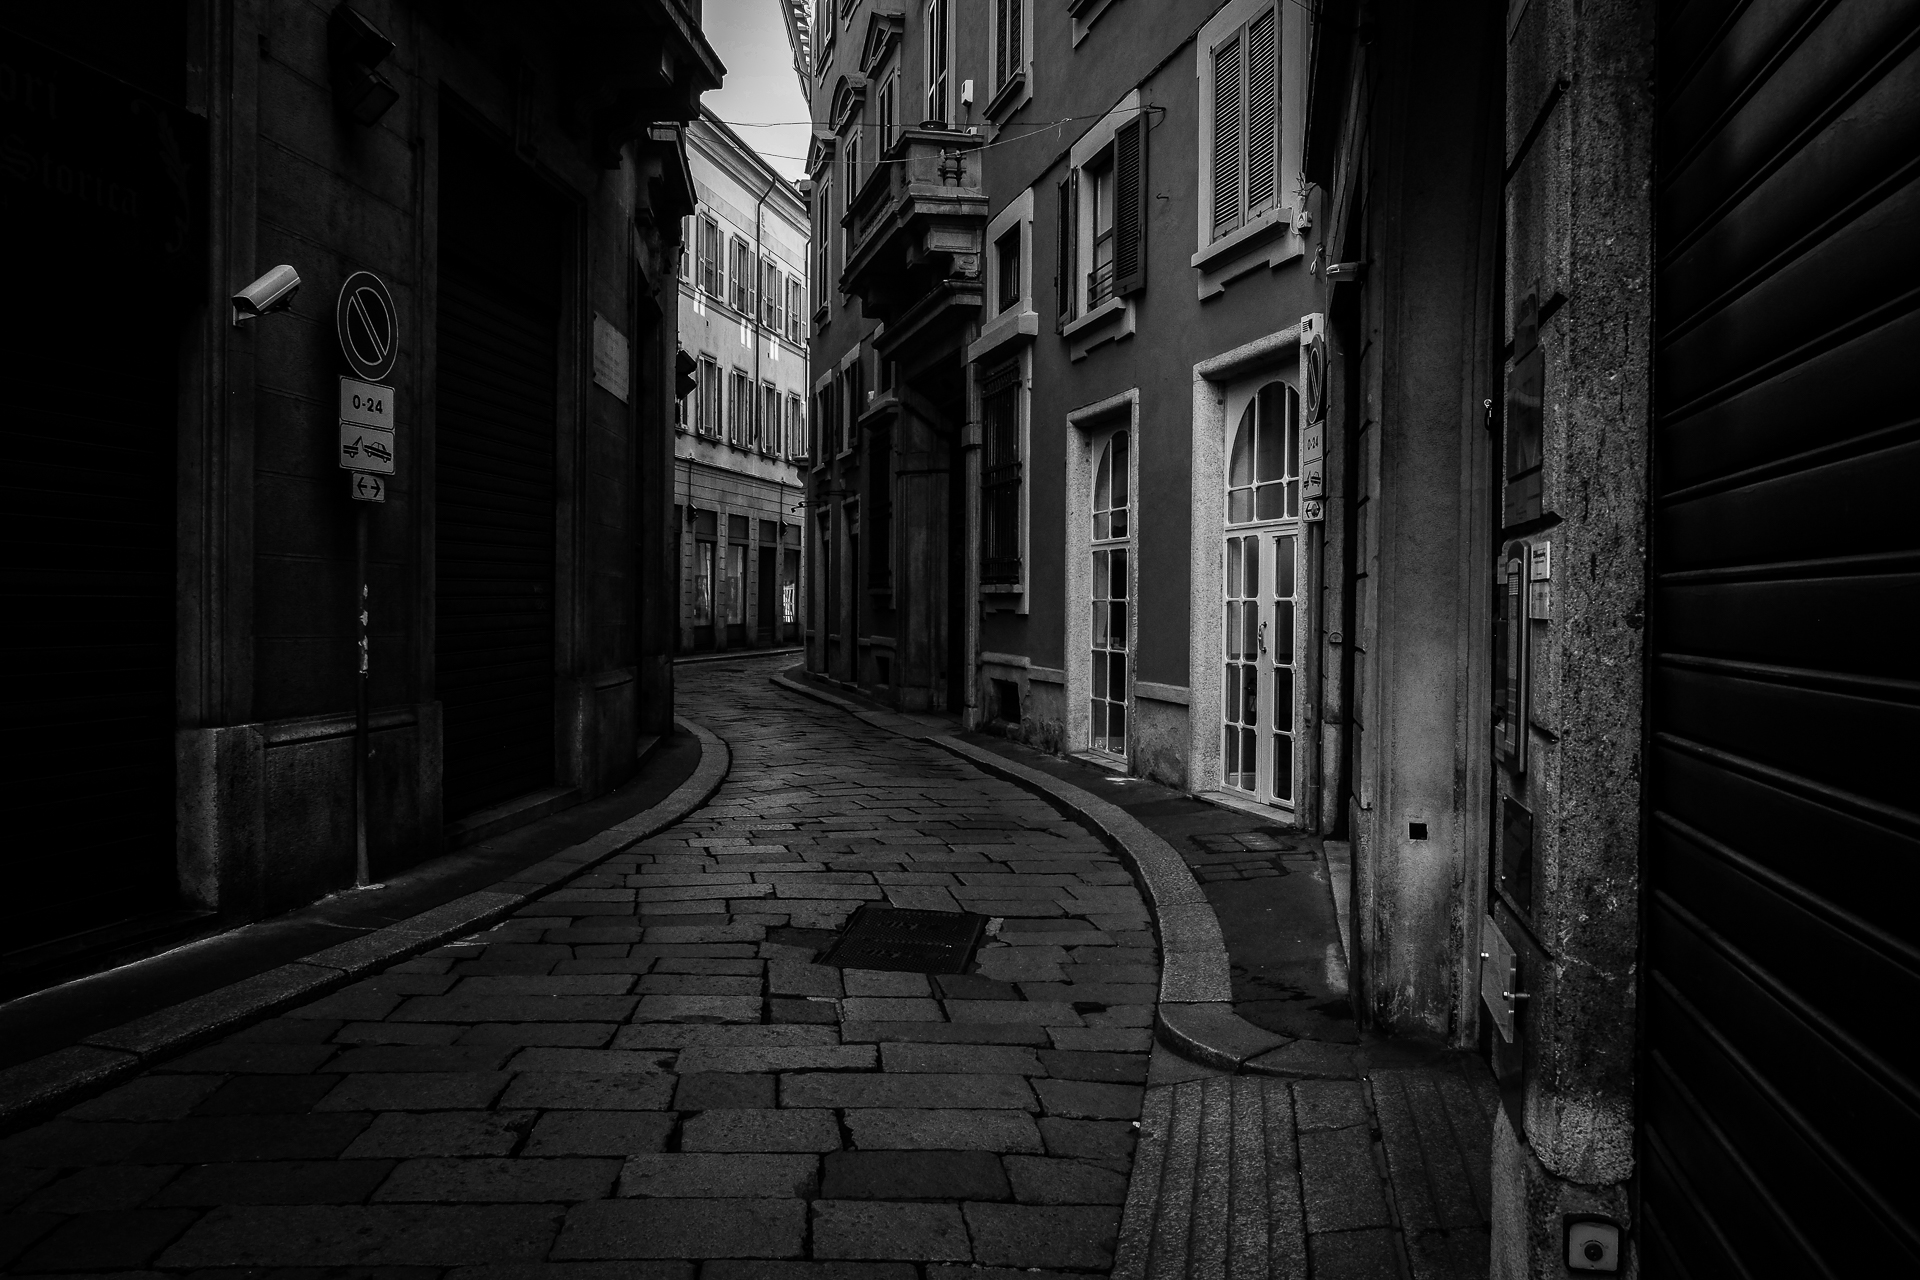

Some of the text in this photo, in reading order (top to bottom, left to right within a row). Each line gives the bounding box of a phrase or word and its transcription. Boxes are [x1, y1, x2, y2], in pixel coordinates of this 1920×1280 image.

[0, 133, 138, 218] Storica
[353, 394, 383, 414] 0-24
[1307, 435, 1319, 451] 0-24
